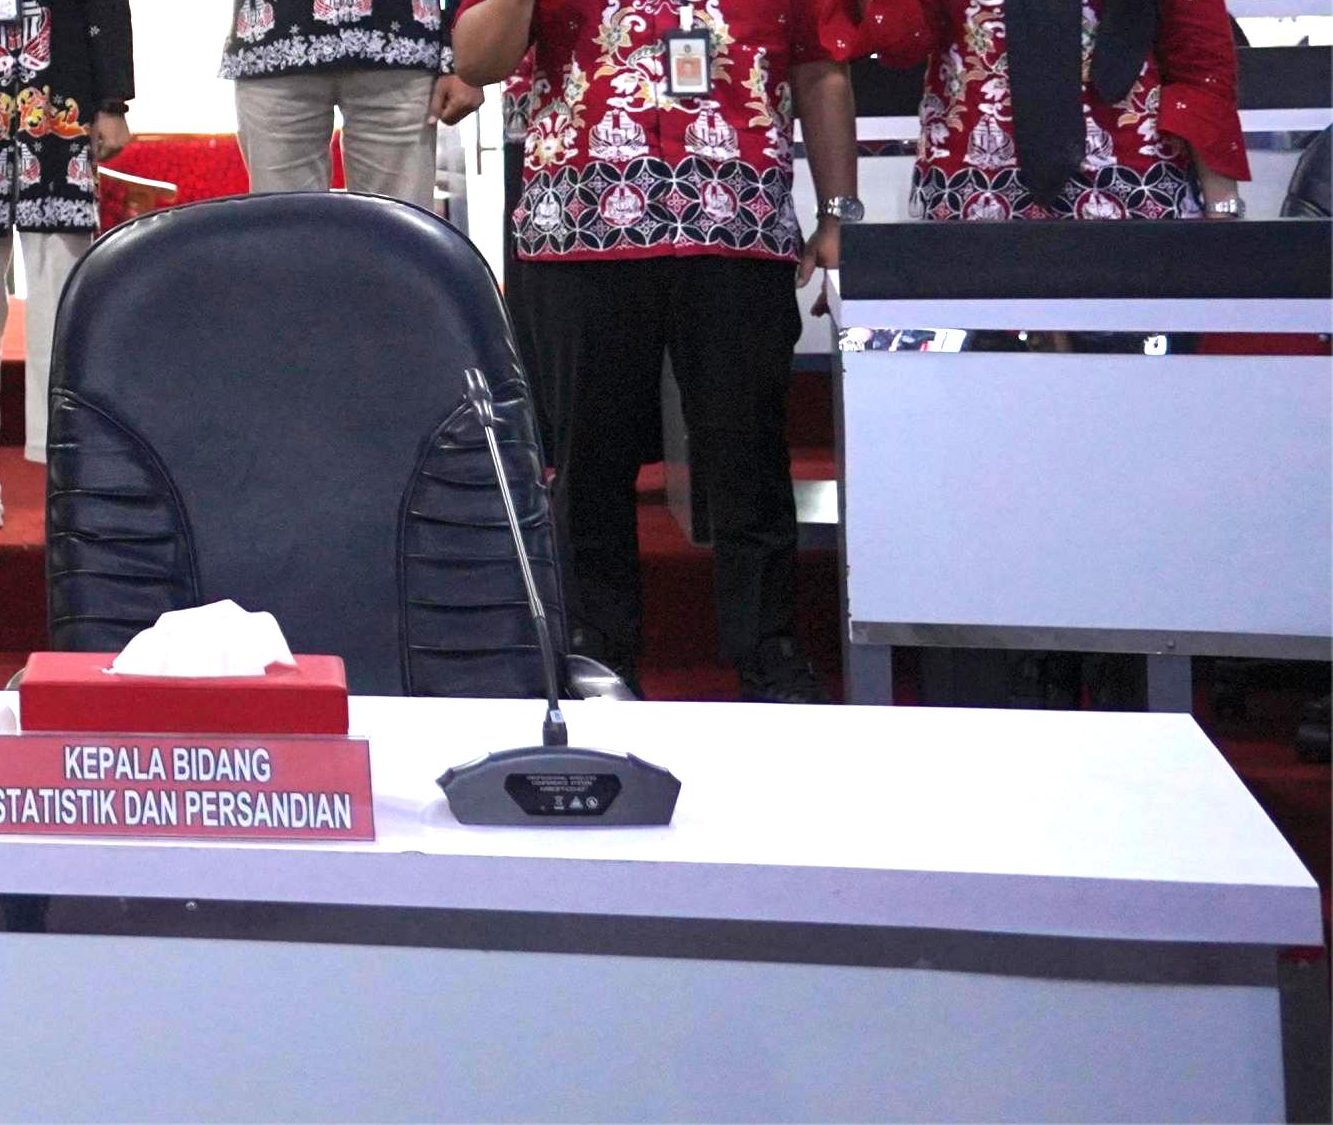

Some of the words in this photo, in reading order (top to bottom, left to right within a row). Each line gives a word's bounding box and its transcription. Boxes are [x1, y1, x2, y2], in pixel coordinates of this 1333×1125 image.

[64, 746, 166, 780] KEPALA
[173, 748, 270, 782] BIDANG
[124, 790, 177, 826] DAN
[185, 791, 352, 829] PERSANDIAN
